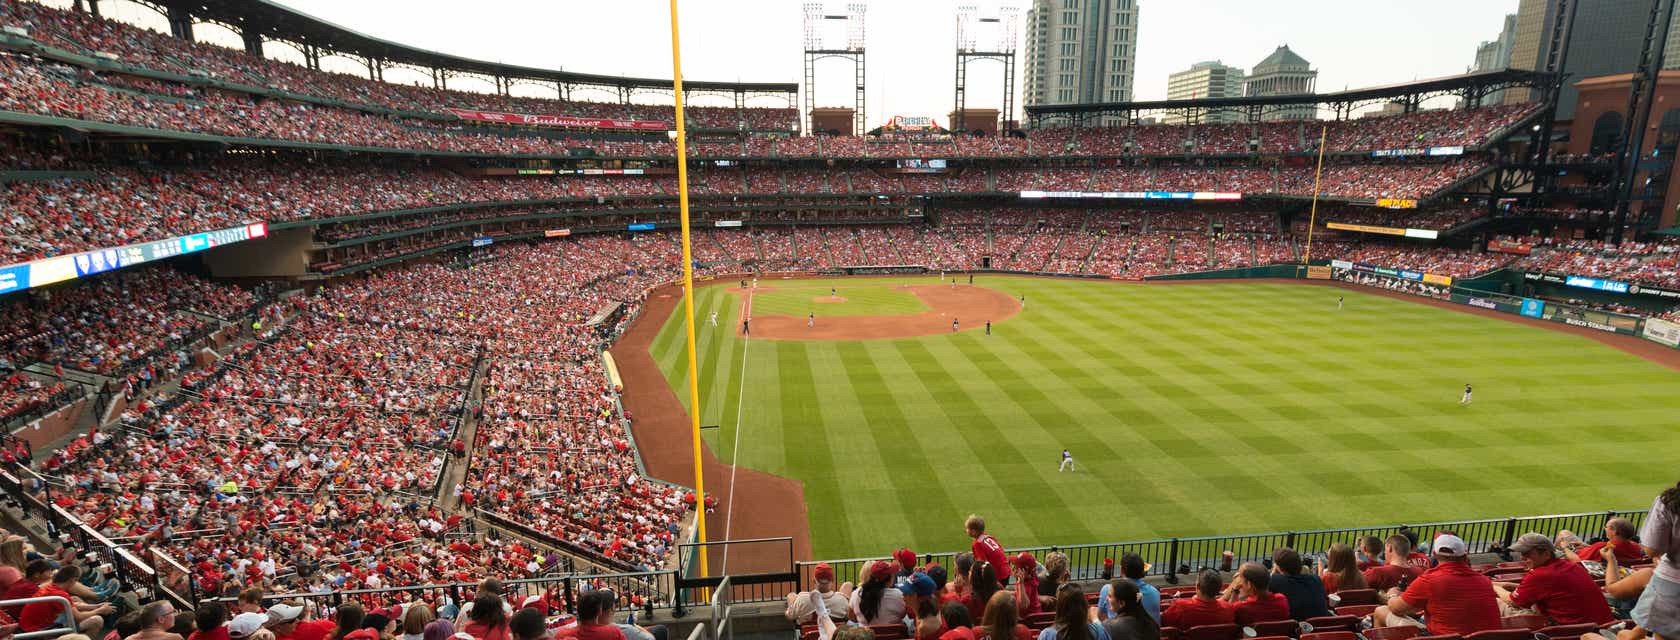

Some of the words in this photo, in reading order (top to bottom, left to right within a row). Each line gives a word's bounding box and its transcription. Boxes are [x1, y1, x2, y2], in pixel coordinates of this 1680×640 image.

[523, 115, 600, 127] Budweiser
[1566, 318, 1587, 327] BUSCH
[1588, 321, 1617, 332] STADIUM
